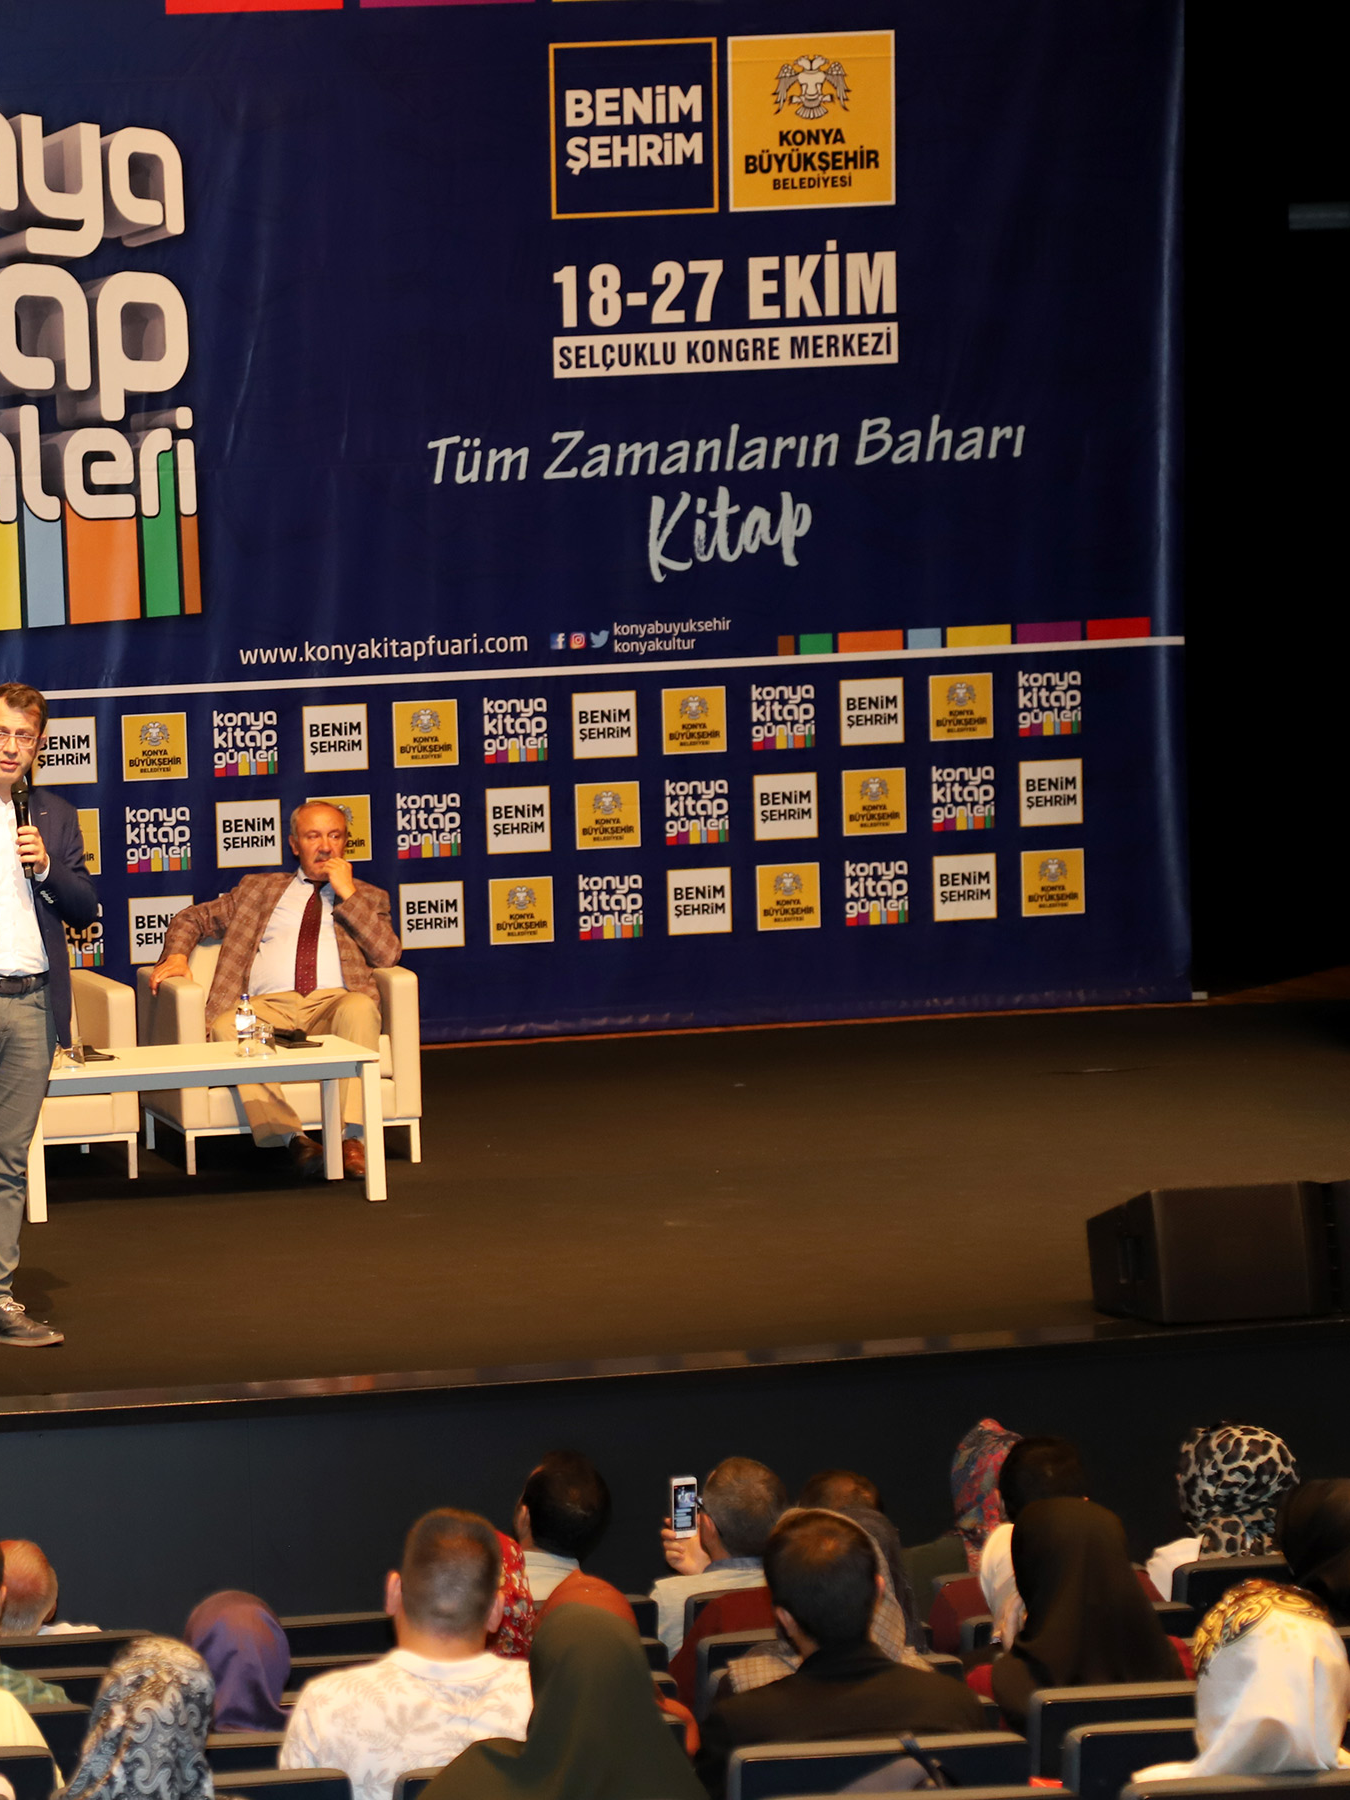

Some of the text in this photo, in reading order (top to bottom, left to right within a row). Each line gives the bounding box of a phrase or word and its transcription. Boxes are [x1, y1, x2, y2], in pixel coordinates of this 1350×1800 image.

[778, 128, 846, 147] KONYA
[744, 145, 880, 174] BÜYÜKŞEHİR
[772, 172, 853, 190] BELEDİYESİ
[553, 239, 897, 328] 18-27 EKİM
[558, 326, 893, 372] SELÇUKLU KONGRE MERKEZİ
[427, 414, 1026, 484] Tüm Zamanların Baharı
[648, 485, 812, 583] Kitap
[613, 617, 732, 637] konyabuyuksehir
[238, 632, 529, 666] www.konyakitapfuari.com
[613, 635, 697, 655] konyakultur
[1018, 671, 1079, 690] konya
[752, 684, 813, 703] konya
[1019, 687, 1080, 709] kitap
[483, 697, 546, 716] konya
[752, 700, 813, 723] kitap
[213, 710, 275, 729] konya
[484, 714, 546, 736] kitap
[214, 726, 276, 749] kitap
[142, 749, 168, 757] KONYA
[932, 766, 993, 785] konya
[665, 779, 727, 798] konya
[933, 782, 993, 804] kitap
[396, 793, 459, 812] konya
[666, 796, 727, 818] kitap
[125, 806, 189, 825] konya
[397, 809, 460, 832] kitap
[126, 823, 190, 845] kitap
[845, 860, 907, 879] konya
[579, 874, 641, 893] konya
[846, 877, 907, 899] kitap
[579, 890, 642, 913] kitap
